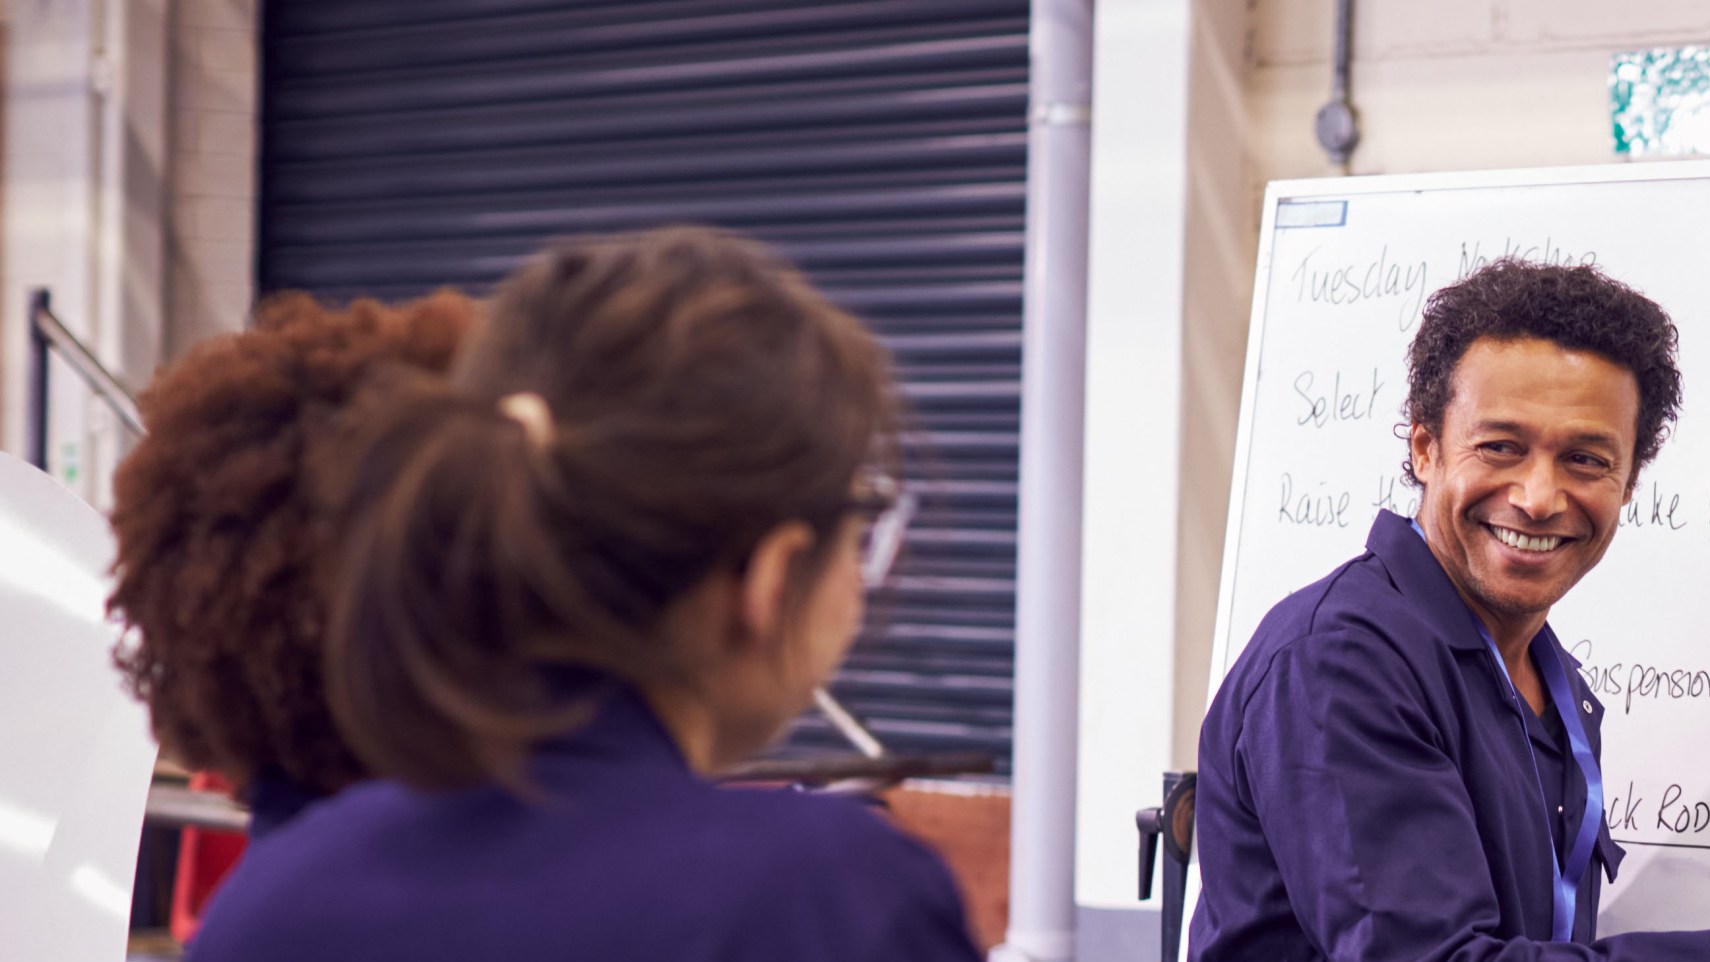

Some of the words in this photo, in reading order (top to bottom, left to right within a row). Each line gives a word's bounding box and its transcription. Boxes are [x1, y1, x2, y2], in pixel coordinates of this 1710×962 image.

[1292, 243, 1427, 333] Tuesday
[1294, 367, 1385, 429] Select
[1279, 472, 1351, 528] Raise
[1618, 480, 1688, 531] ake
